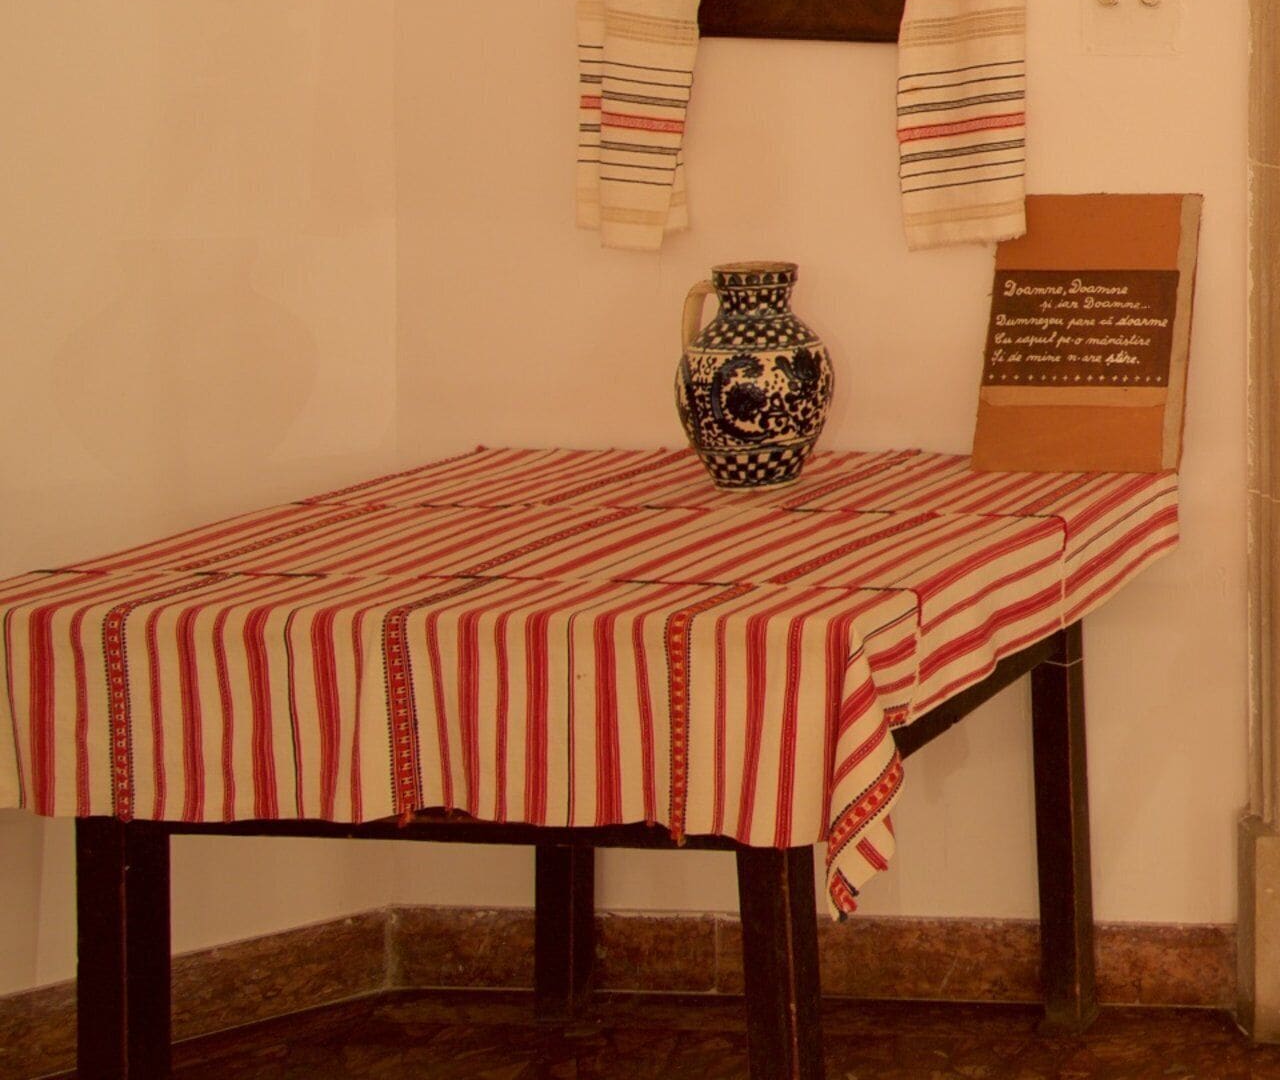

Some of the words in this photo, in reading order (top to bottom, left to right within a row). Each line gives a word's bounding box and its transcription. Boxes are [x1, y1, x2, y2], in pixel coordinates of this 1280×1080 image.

[1068, 277, 1129, 295] Doamne
[995, 313, 1065, 330] Dumnezeu
[1066, 317, 1096, 330] pare
[1115, 314, 1169, 328] doarme
